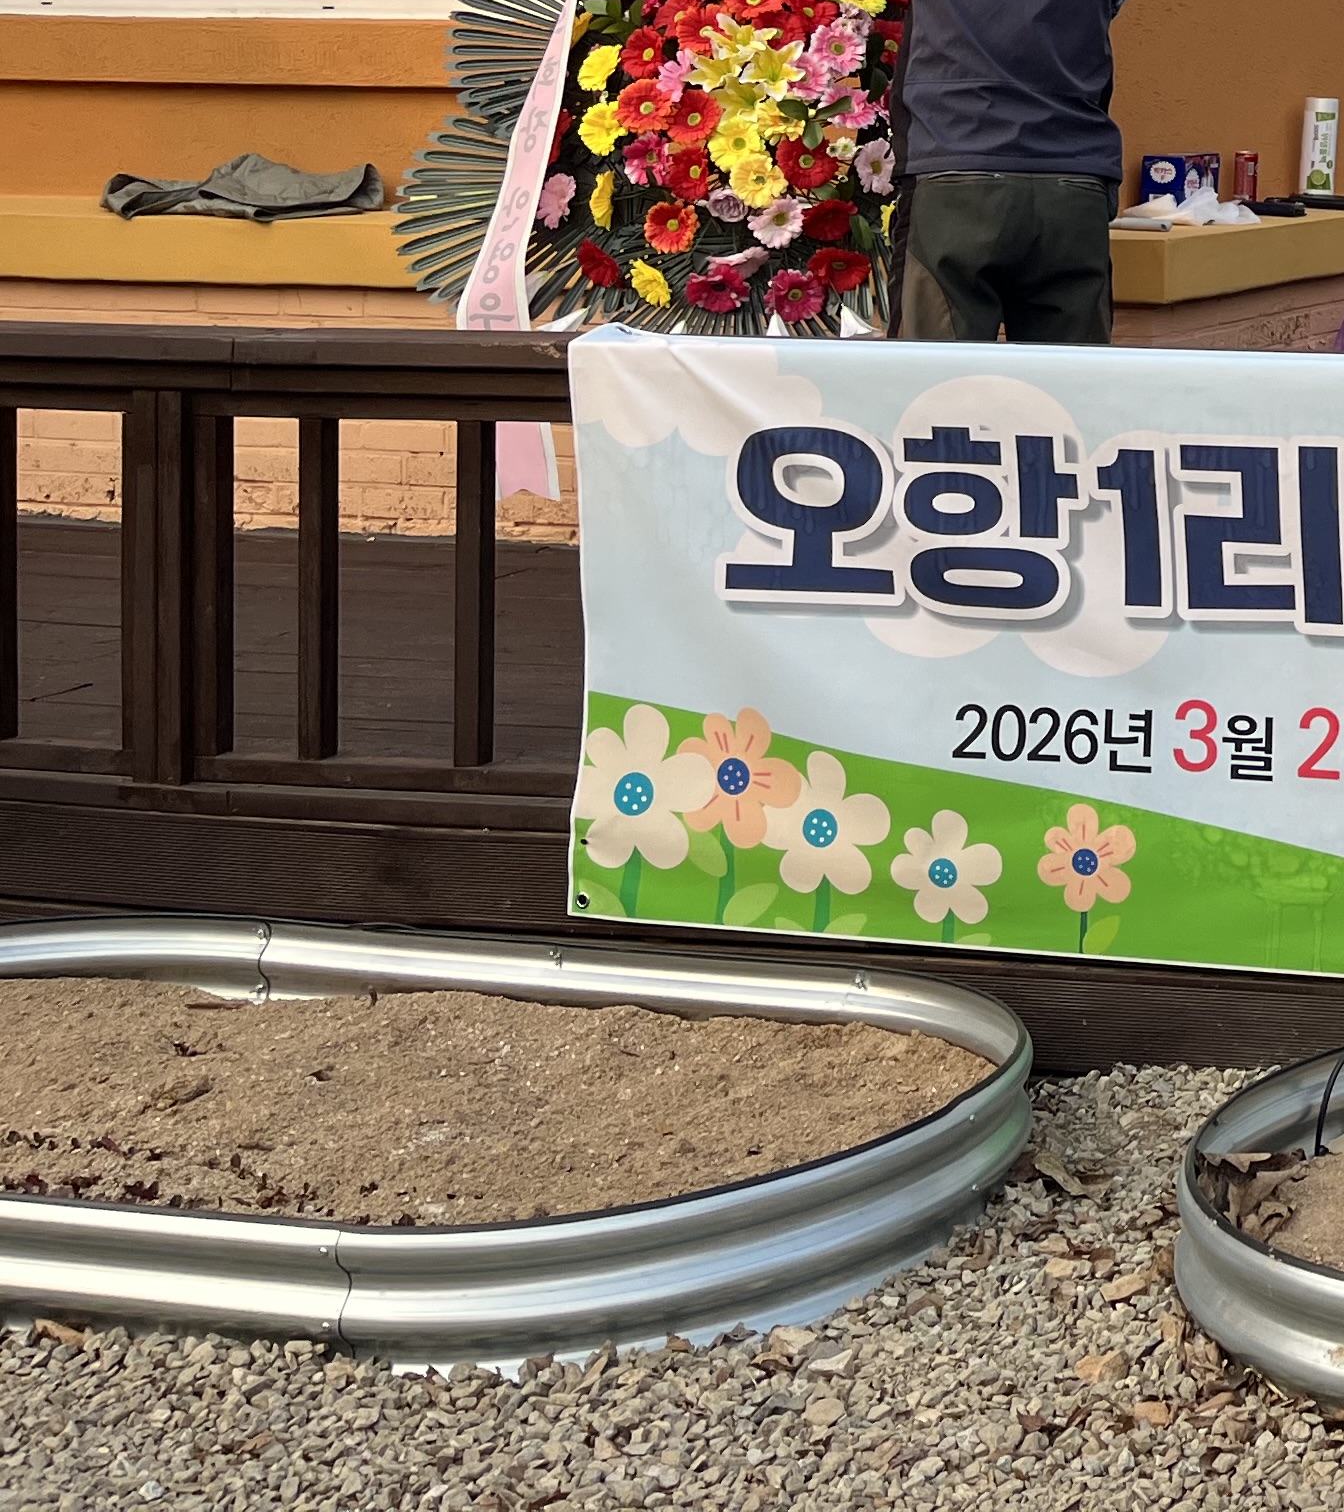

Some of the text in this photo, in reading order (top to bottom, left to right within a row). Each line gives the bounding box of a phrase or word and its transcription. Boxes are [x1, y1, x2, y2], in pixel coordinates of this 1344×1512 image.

[725, 426, 1342, 625] 오항1리
[952, 704, 1153, 774] 2026년
[1173, 699, 1274, 782] 3월
